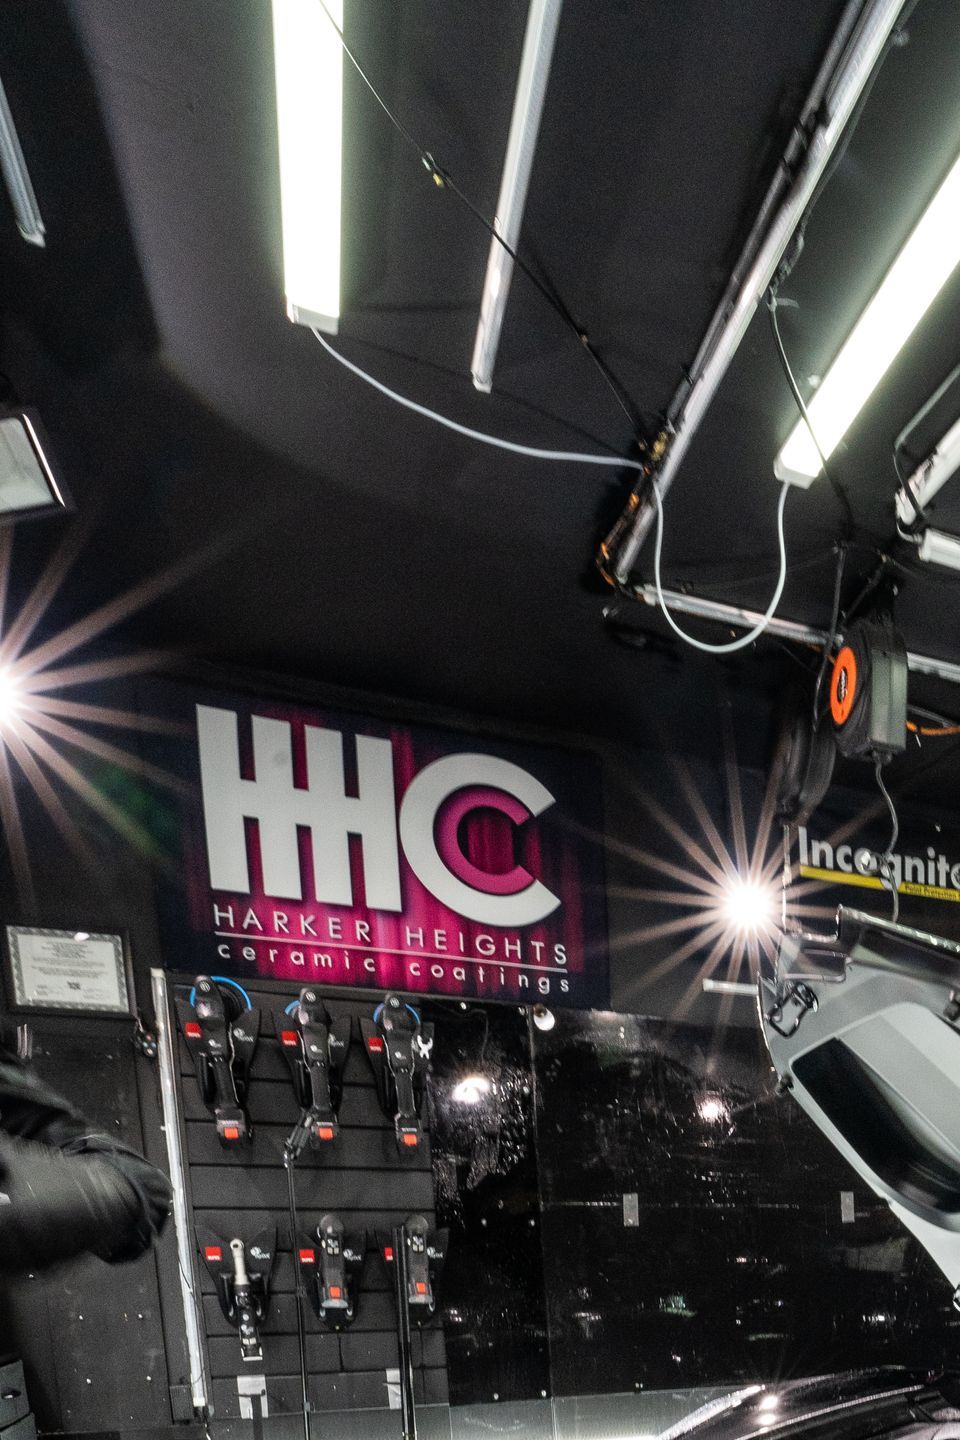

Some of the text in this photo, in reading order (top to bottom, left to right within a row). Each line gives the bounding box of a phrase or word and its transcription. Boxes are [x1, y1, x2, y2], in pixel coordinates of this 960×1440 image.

[213, 904, 567, 965] HARKER HEIGHTS
[218, 943, 569, 994] ceramic coatings
